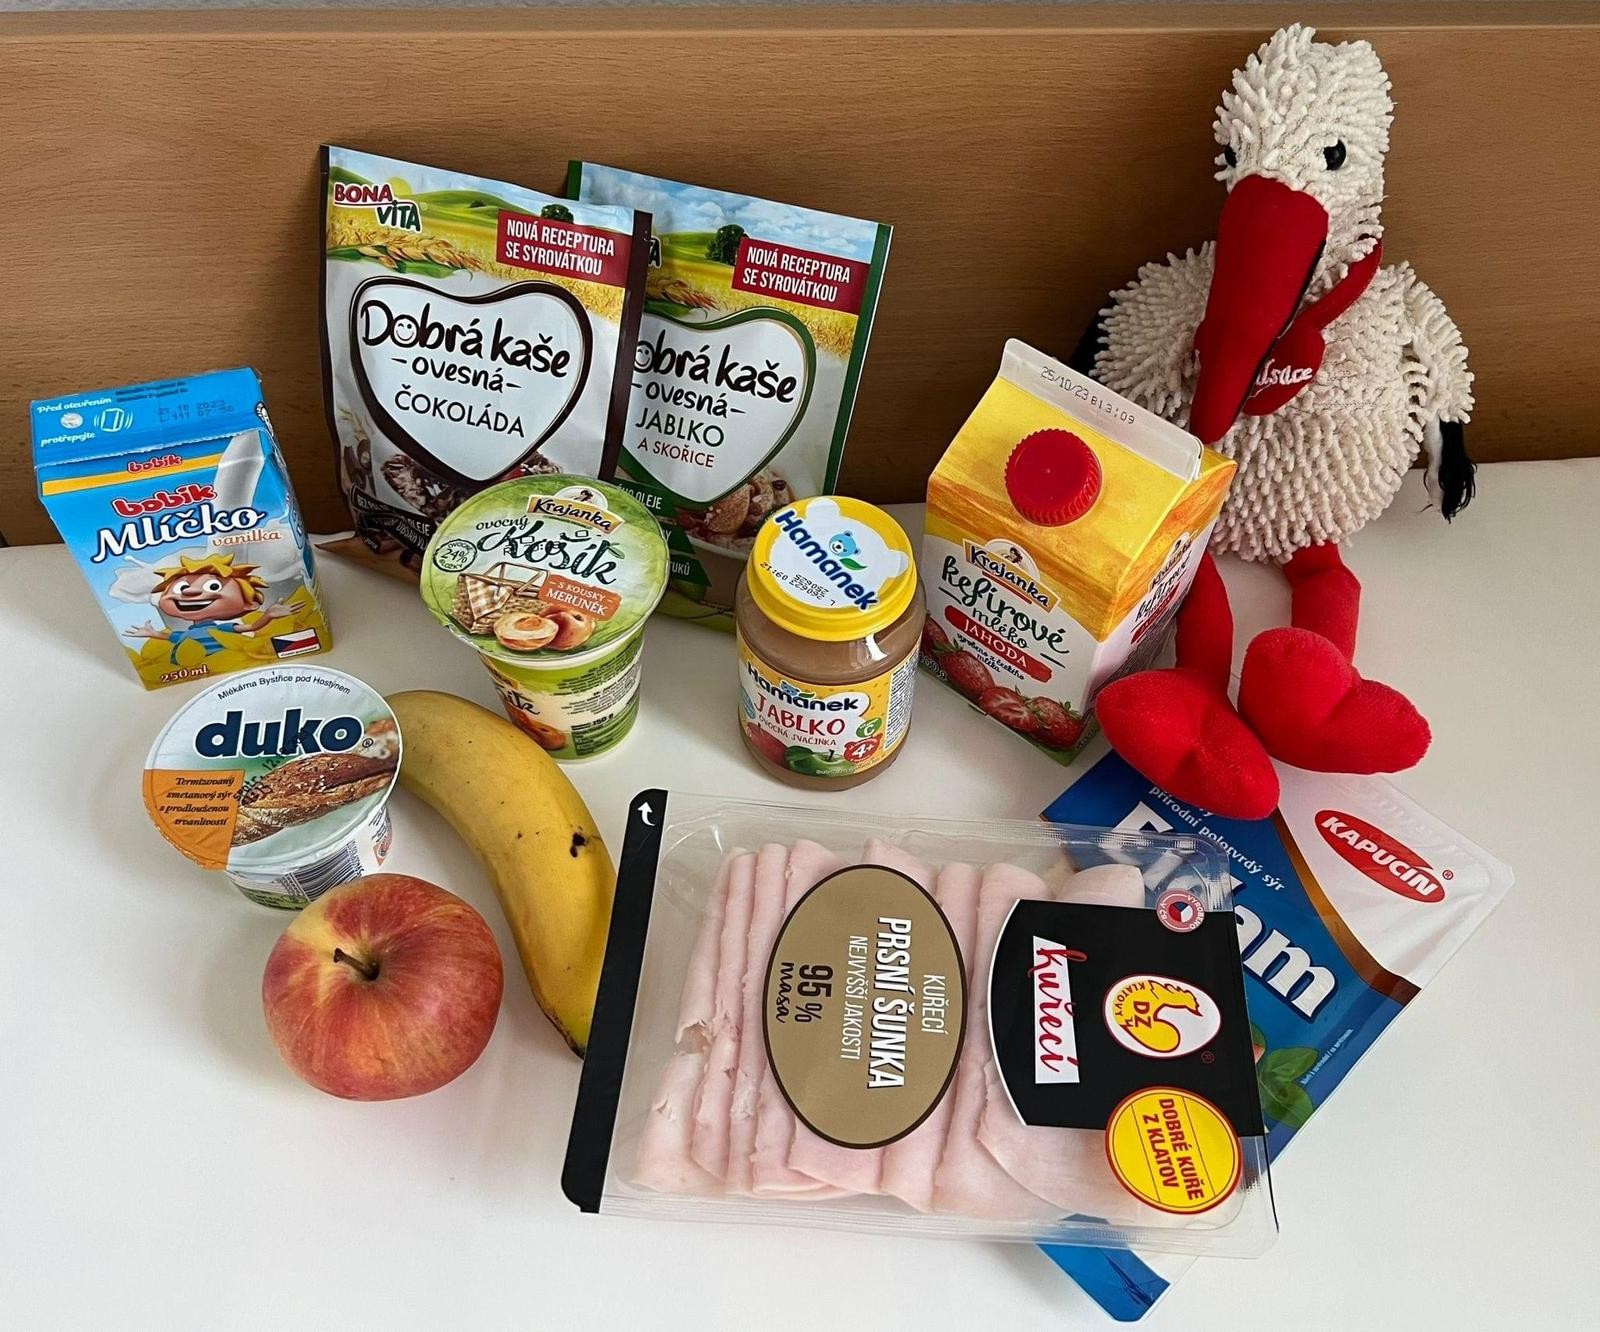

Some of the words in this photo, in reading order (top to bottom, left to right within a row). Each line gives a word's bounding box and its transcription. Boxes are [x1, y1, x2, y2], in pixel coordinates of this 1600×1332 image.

[334, 184, 393, 202] BONA
[377, 201, 421, 231] VITA
[507, 220, 538, 241] NOVÁ
[542, 225, 615, 256] RECEPTURA
[506, 242, 520, 259] SE
[523, 243, 602, 276] SYROVÁTKOU
[747, 247, 779, 268] NOVÁ
[781, 254, 851, 284] RECEPTURA
[742, 269, 757, 285] SE
[760, 270, 838, 302] SYROVÁTKOU
[360, 299, 484, 358] Dobrá
[491, 318, 570, 377] kaše
[412, 357, 503, 393] ovesná
[634, 330, 711, 385] obrá
[715, 345, 797, 402] kaše
[1041, 366, 1089, 401] 25/10/23
[64, 397, 112, 410] otevřením
[395, 384, 524, 437] ČOKOLÁDA
[646, 381, 727, 418] ovesná
[41, 432, 96, 447] protřepejte
[636, 407, 725, 448] JABLKO
[637, 440, 649, 452] A
[653, 442, 715, 468] SKOŘICE
[475, 515, 529, 531] ovocný
[537, 498, 612, 531] Krajanka
[92, 502, 265, 564] Mlíčko
[212, 529, 282, 548] vanilka
[477, 520, 617, 585] Košík
[557, 581, 565, 589] S
[567, 584, 605, 602] KOUSKY
[969, 543, 1051, 607] Krajanka
[941, 554, 1070, 655] kefírové
[963, 618, 1028, 669] JAHODA
[972, 607, 1027, 649] mléko
[160, 667, 187, 683] 250
[189, 664, 209, 677] ml
[217, 681, 258, 701] Mlékárna
[259, 673, 294, 686] Bystřice
[295, 674, 312, 684] pod
[313, 675, 352, 695] Hostýnem
[194, 707, 363, 758] duko
[754, 692, 846, 737] JABLKO
[166, 790, 217, 802] smetanový
[217, 790, 234, 802] sýr
[175, 776, 235, 788] Termizovaný
[159, 805, 166, 813] s
[166, 804, 230, 814] prodlouženou
[174, 816, 228, 827] trvanlivostí
[1320, 815, 1440, 896] KAPUCÍN
[1261, 872, 1286, 892] sýr
[844, 935, 868, 1001] NEJVYŠŠÍ
[874, 916, 914, 997] PRSNÍ
[775, 961, 797, 1024] masa
[798, 963, 834, 999] 95
[1115, 982, 1146, 1016] KLATOVY
[794, 1001, 823, 1024] %
[921, 974, 949, 1036] KUŘECÍ
[1027, 947, 1088, 1073] kuřecí
[840, 1001, 866, 1061] JAKOSTI
[867, 997, 915, 1090] ŠUNKA
[1142, 1113, 1160, 1124] Z
[1147, 1127, 1180, 1188] KLATOV
[1158, 1098, 1193, 1153] DOBRÉ
[1176, 1155, 1205, 1200] KUŘE
